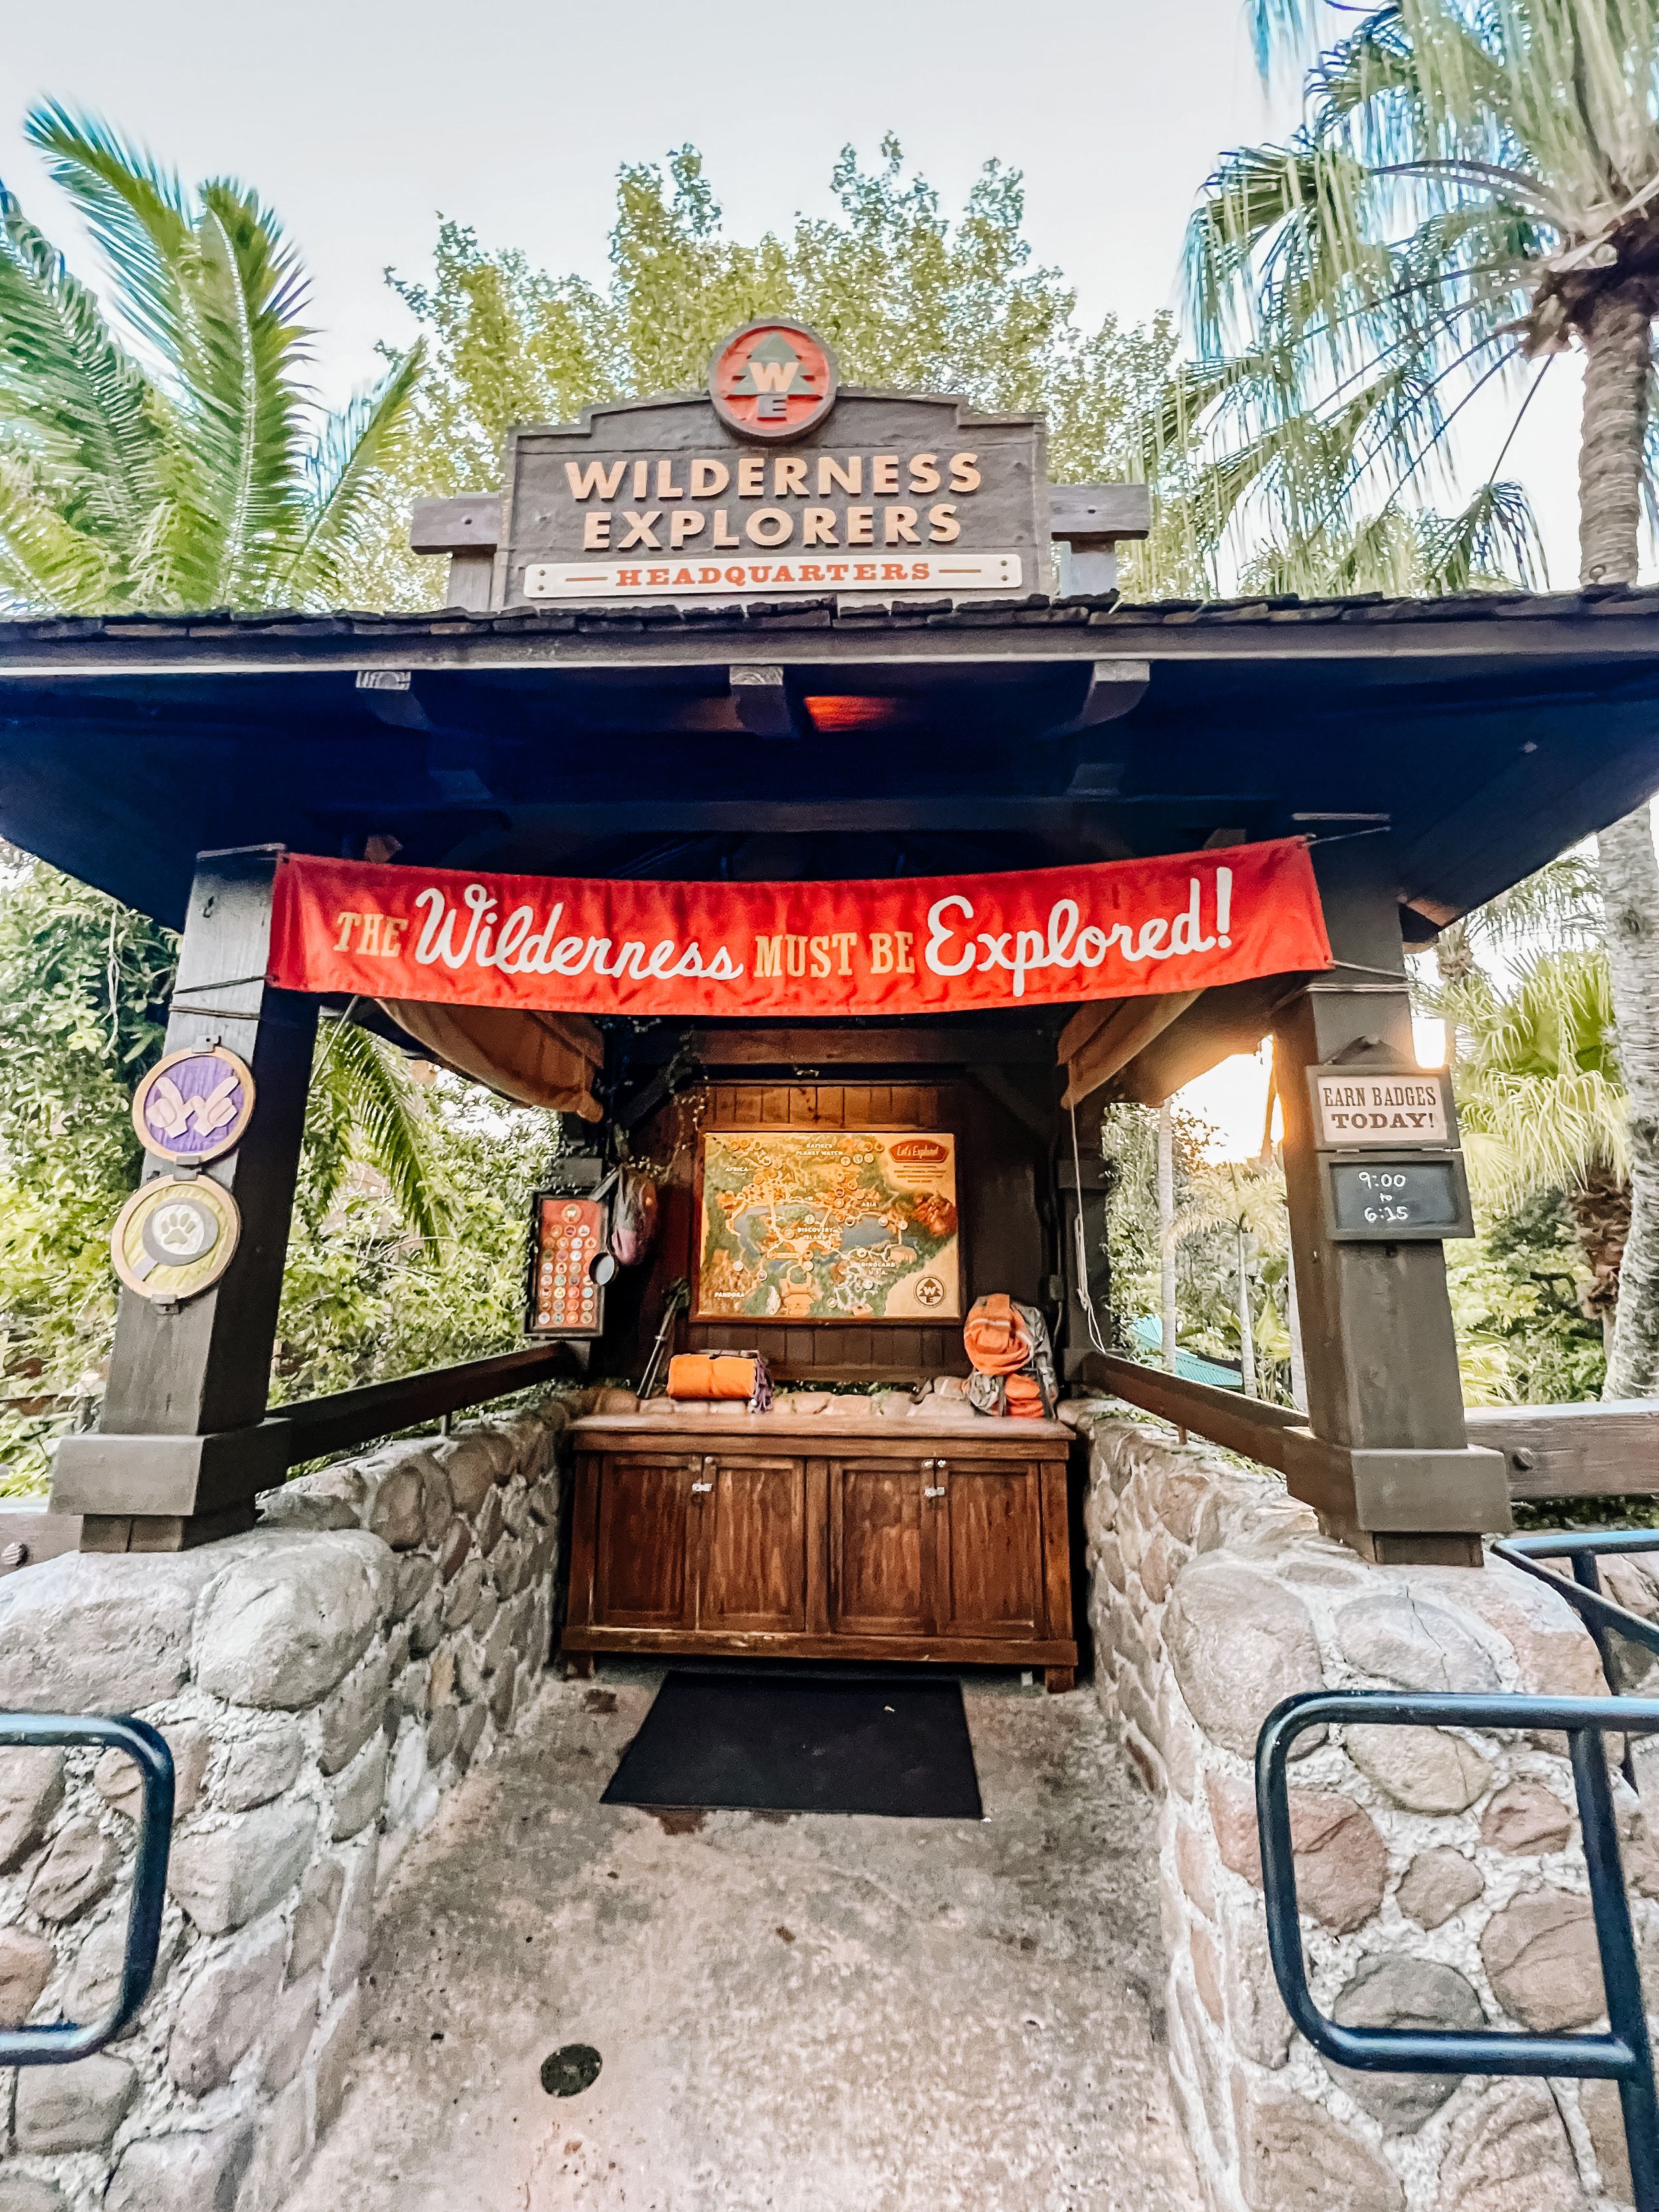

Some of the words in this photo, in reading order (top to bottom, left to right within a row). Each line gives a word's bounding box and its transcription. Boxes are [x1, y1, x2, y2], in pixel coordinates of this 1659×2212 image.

[749, 362, 800, 392] W
[564, 451, 982, 500] WILDERNESS
[583, 503, 961, 551] EXPLORERS
[616, 563, 930, 587] HEADQUARTERS
[333, 912, 407, 957] THE
[414, 883, 745, 980] Wilderness
[753, 932, 857, 978] MUST
[870, 930, 915, 974] BE
[924, 866, 1232, 997] Explored!
[1323, 1086, 1366, 1107] EARN
[1372, 1086, 1436, 1106] BADGES
[1331, 1112, 1434, 1129] TODAY!
[1358, 1171, 1406, 1189] 9:00
[1380, 1193, 1393, 1203] to
[1364, 1206, 1409, 1223] 6:15
